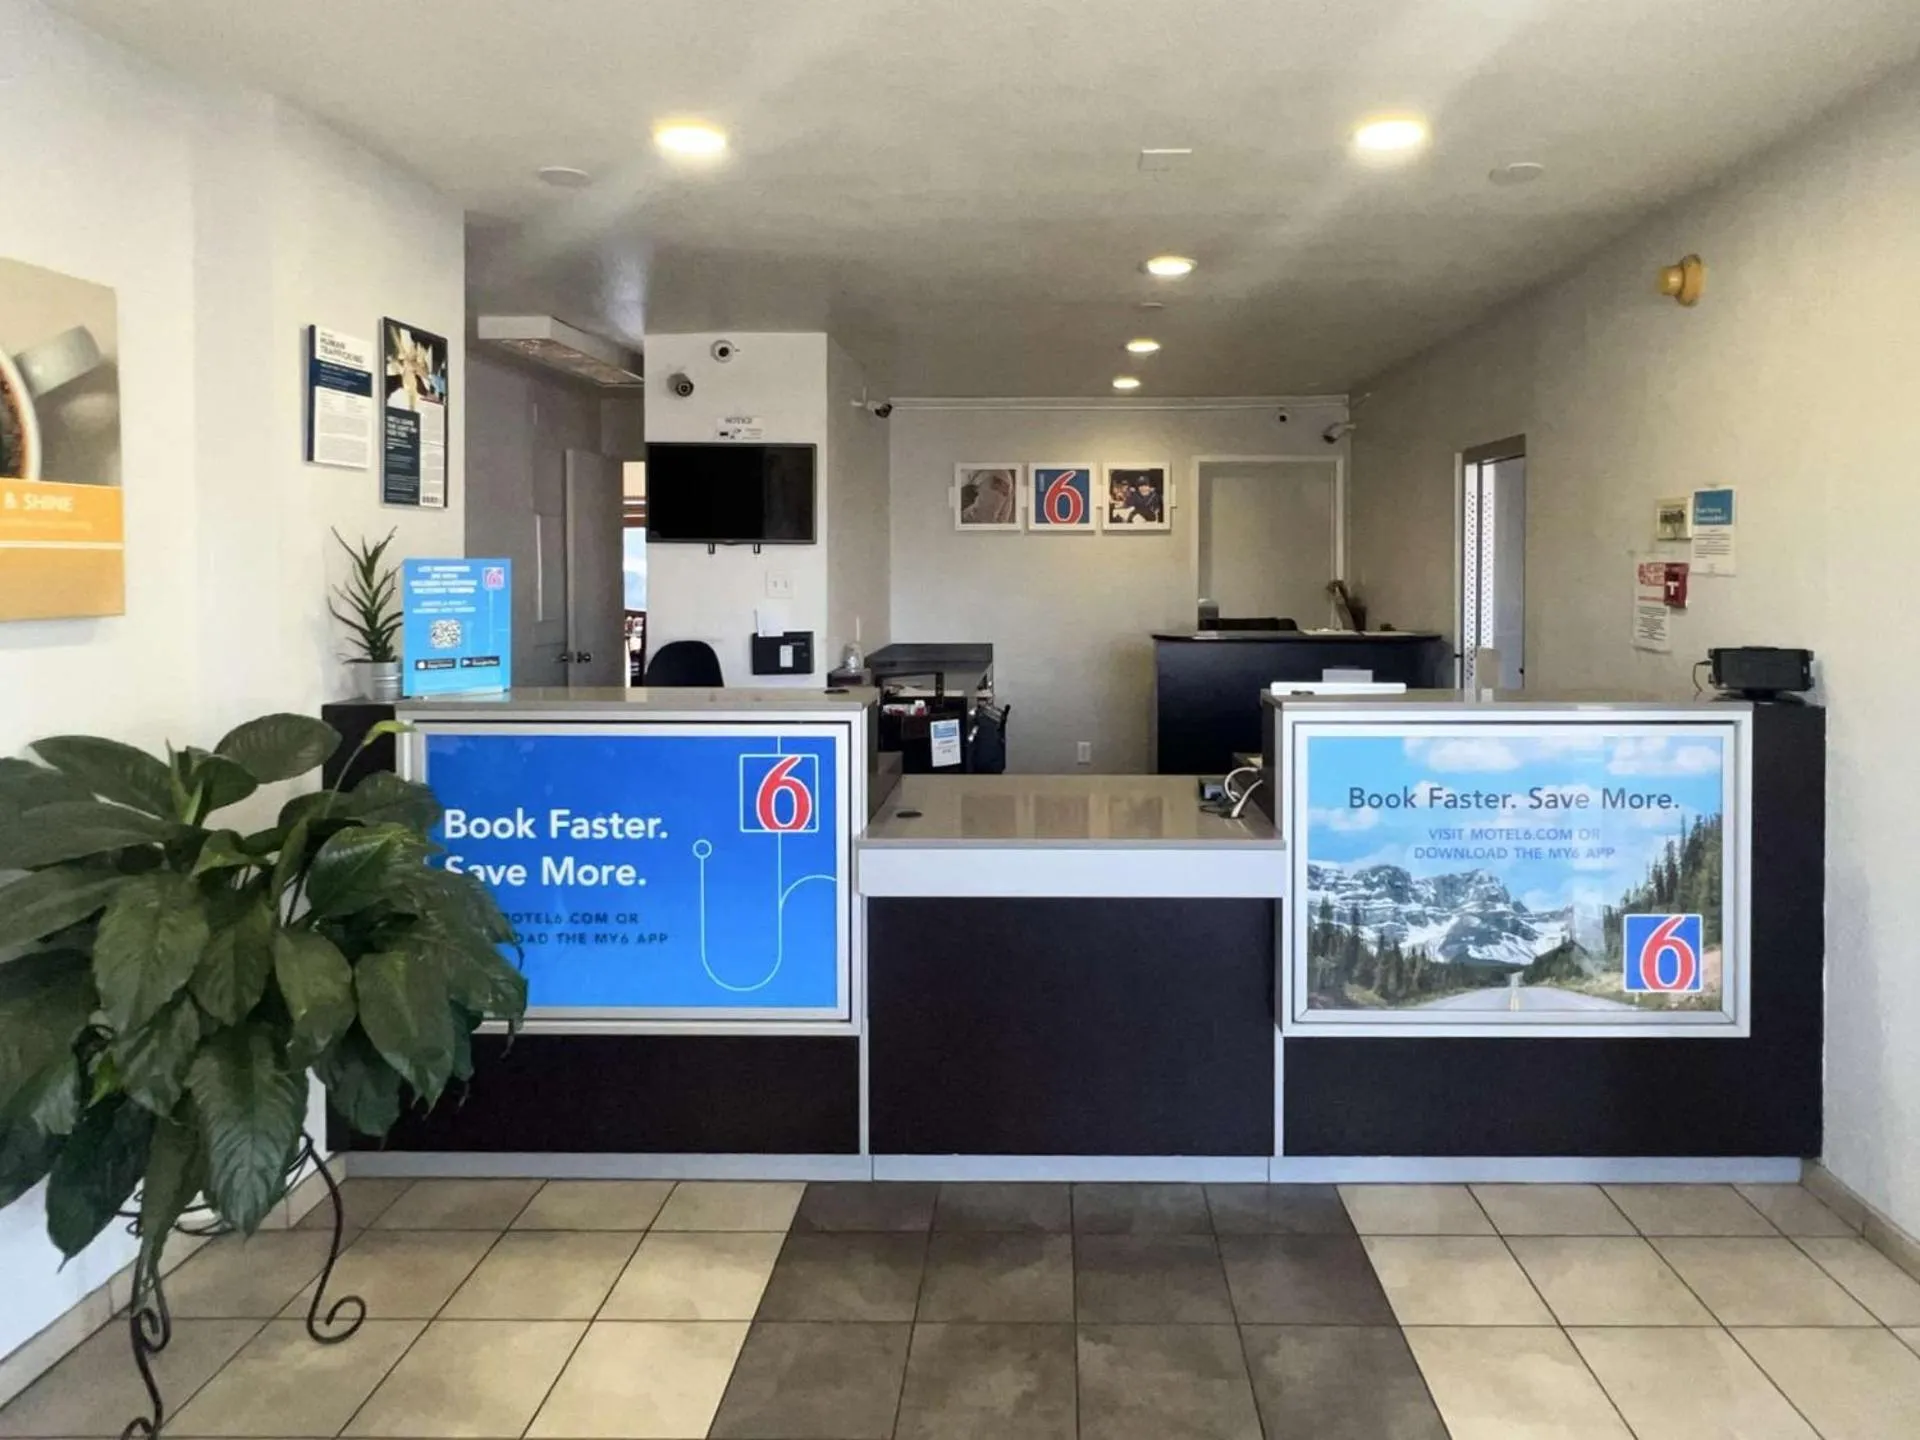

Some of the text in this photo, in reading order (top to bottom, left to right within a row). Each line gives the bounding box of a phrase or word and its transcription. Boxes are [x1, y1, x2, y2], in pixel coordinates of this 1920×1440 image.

[23, 493, 74, 513] SHINE
[1043, 470, 1083, 525] 6
[756, 754, 812, 832] 6
[1349, 786, 1680, 810] Book Faster. Save More.
[445, 808, 669, 839] Book Faster.
[1428, 828, 1600, 841] VISIT MOTEL6.COM OR
[1414, 847, 1615, 859] DOWNLOAD THE MY6 APP
[542, 856, 647, 886] More.
[616, 912, 639, 924] OR
[557, 932, 587, 944] THE
[595, 932, 628, 944] MY6
[637, 932, 668, 944] APP
[1640, 914, 1696, 992] 6
